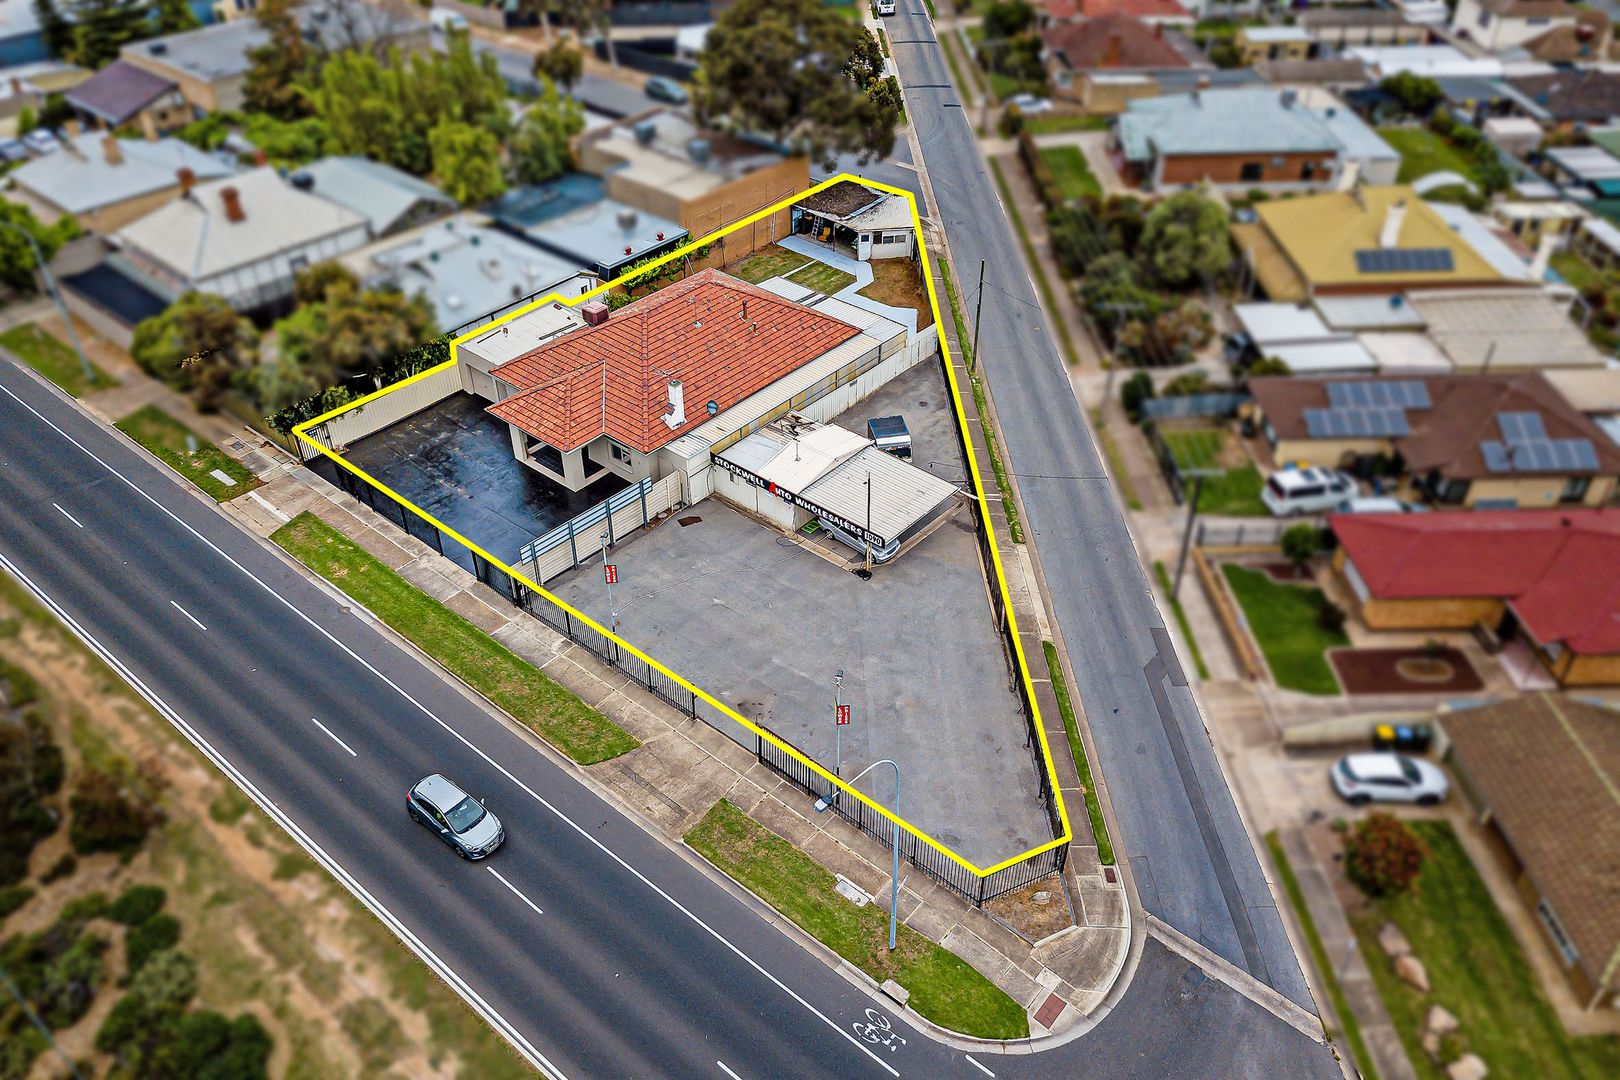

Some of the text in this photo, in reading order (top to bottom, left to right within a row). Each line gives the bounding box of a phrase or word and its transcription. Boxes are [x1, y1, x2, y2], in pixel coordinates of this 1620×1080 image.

[714, 457, 765, 487] STOCKWELL
[769, 482, 792, 500] AUTO
[795, 497, 863, 536] WHOLESALERS
